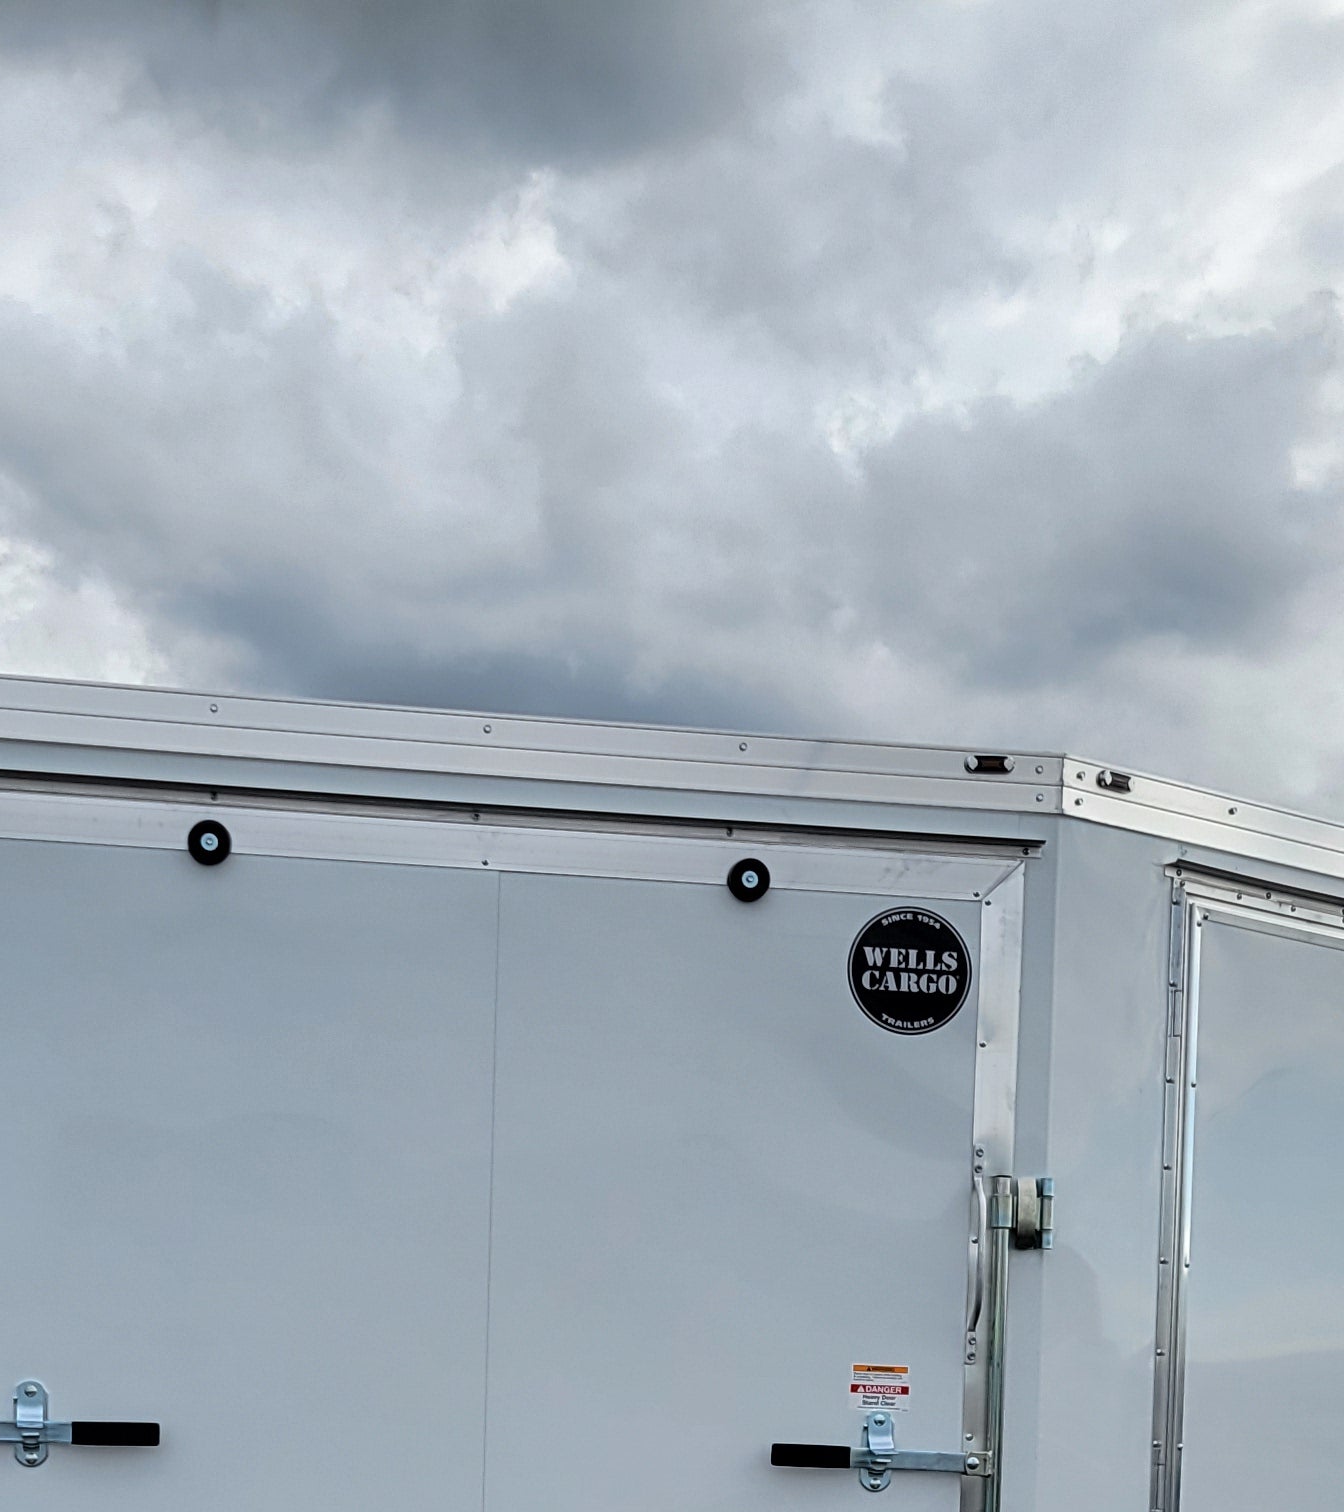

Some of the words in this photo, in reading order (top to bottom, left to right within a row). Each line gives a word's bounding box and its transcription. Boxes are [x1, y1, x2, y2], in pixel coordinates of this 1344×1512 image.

[881, 913, 913, 926] SINCE
[917, 914, 941, 929] 1954
[862, 946, 958, 972] WELLS
[861, 970, 958, 995] CARGO
[881, 1013, 935, 1029] TRAILERS
[865, 1385, 902, 1394] DANGER
